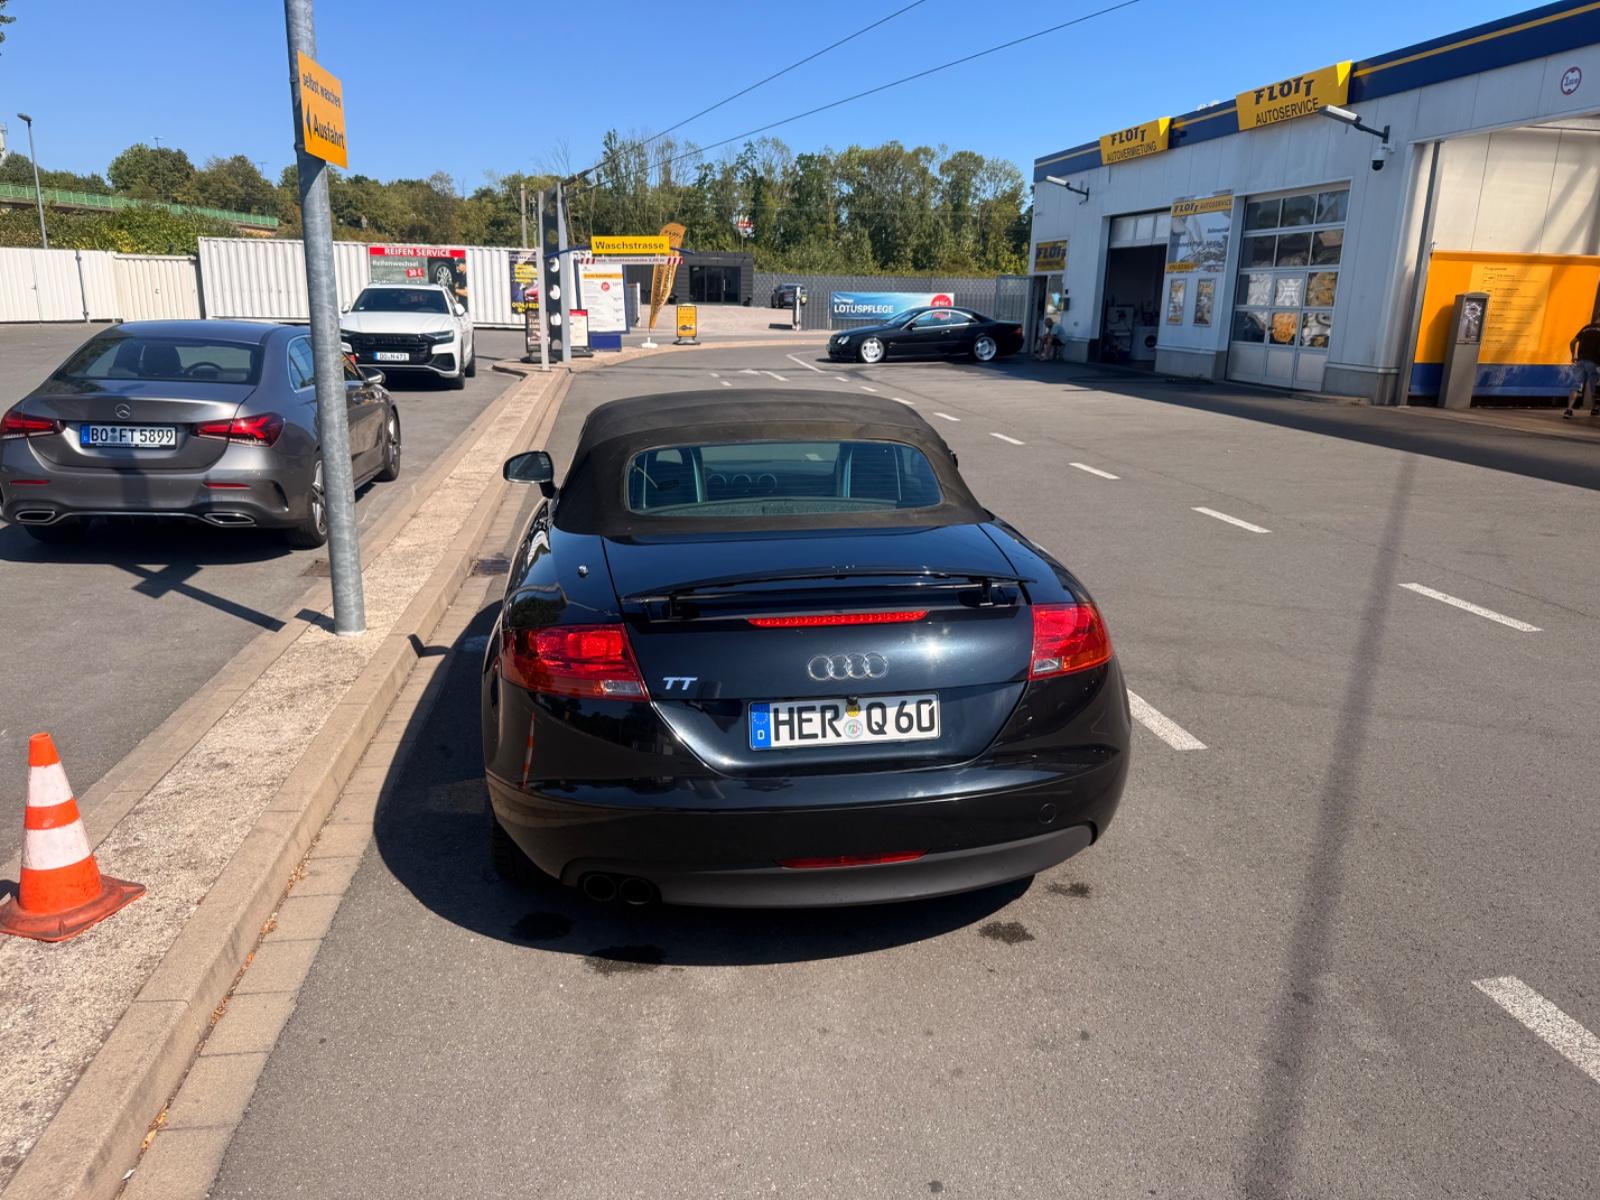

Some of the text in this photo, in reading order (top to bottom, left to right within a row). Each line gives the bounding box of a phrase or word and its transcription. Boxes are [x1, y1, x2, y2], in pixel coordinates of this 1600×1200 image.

[1254, 76, 1314, 104] FLOTT
[1256, 97, 1318, 125] AUTOSERVICE
[313, 113, 345, 150] Ausfahrt
[1110, 127, 1146, 146] FLOTT
[1107, 141, 1157, 162] AUTOVERMIETUNG
[384, 248, 450, 257] REIFEN SERVICE
[595, 241, 664, 250] Waschstrasse
[834, 304, 894, 313] LOTUSPFLEGE
[91, 427, 109, 442] BO
[119, 428, 136, 442] FT
[139, 428, 173, 444] 5899
[663, 676, 698, 690] TT
[757, 699, 936, 741] D HER Q 60
